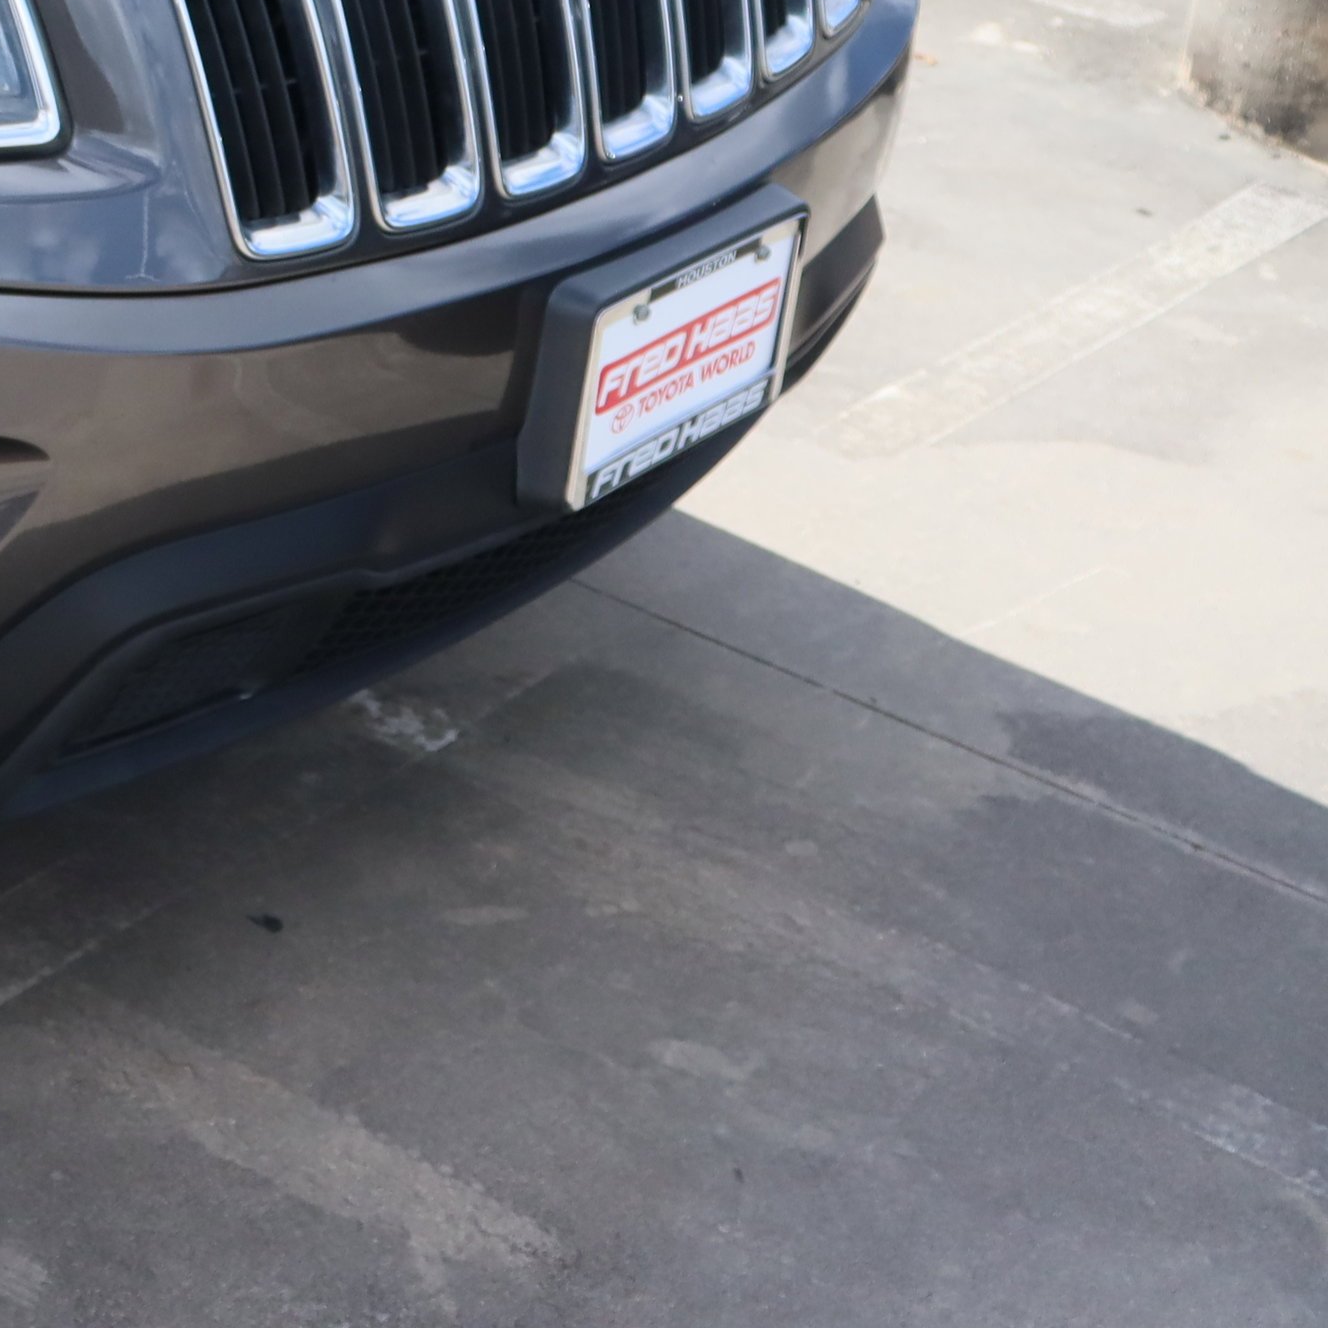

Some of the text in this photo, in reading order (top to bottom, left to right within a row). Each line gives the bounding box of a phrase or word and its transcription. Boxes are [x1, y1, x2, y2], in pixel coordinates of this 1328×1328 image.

[675, 249, 738, 289] HOUSTON
[639, 340, 756, 417] TOYOTA WORLD
